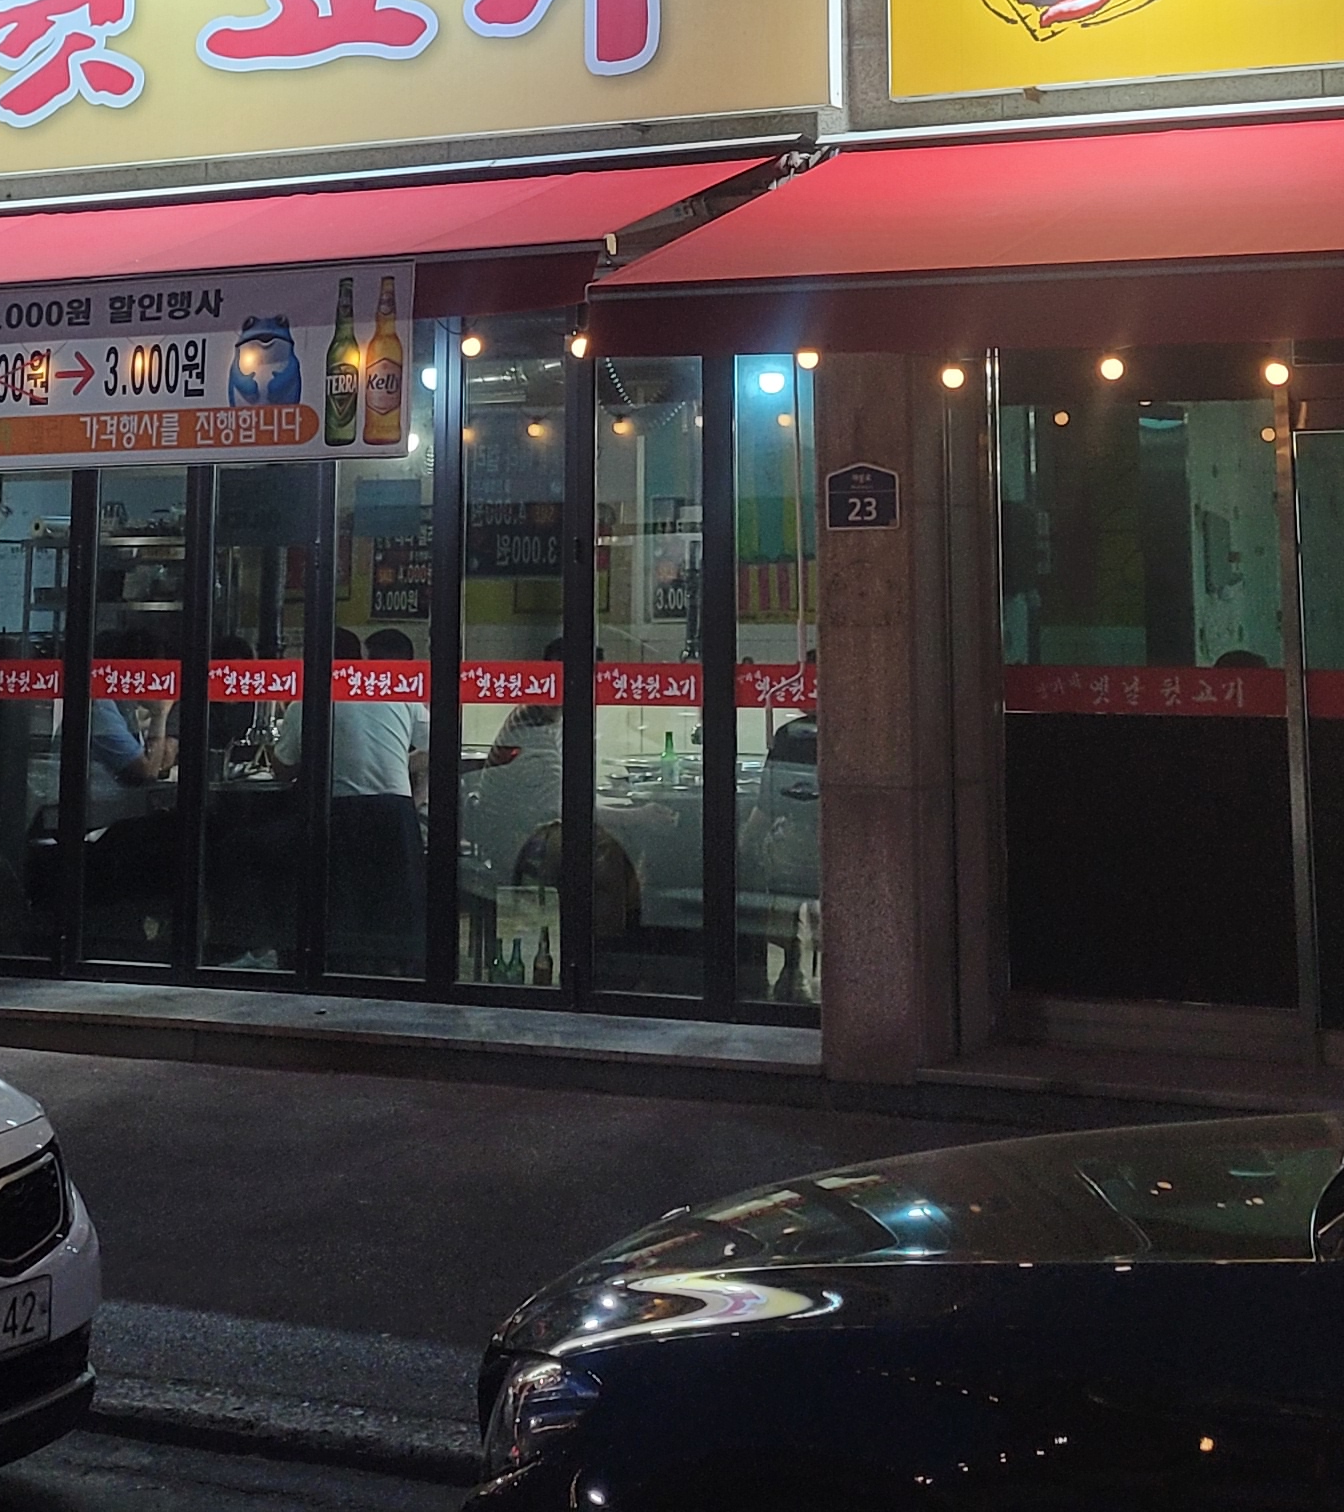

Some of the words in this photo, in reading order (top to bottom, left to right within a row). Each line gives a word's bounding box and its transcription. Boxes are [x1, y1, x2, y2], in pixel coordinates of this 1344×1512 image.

[108, 288, 224, 325] 할인행사
[103, 338, 207, 398] 3.000원
[78, 413, 181, 450] 가격행사를
[194, 407, 303, 444] 진행합니다
[847, 497, 878, 522] 23
[374, 589, 419, 613] 3.000원
